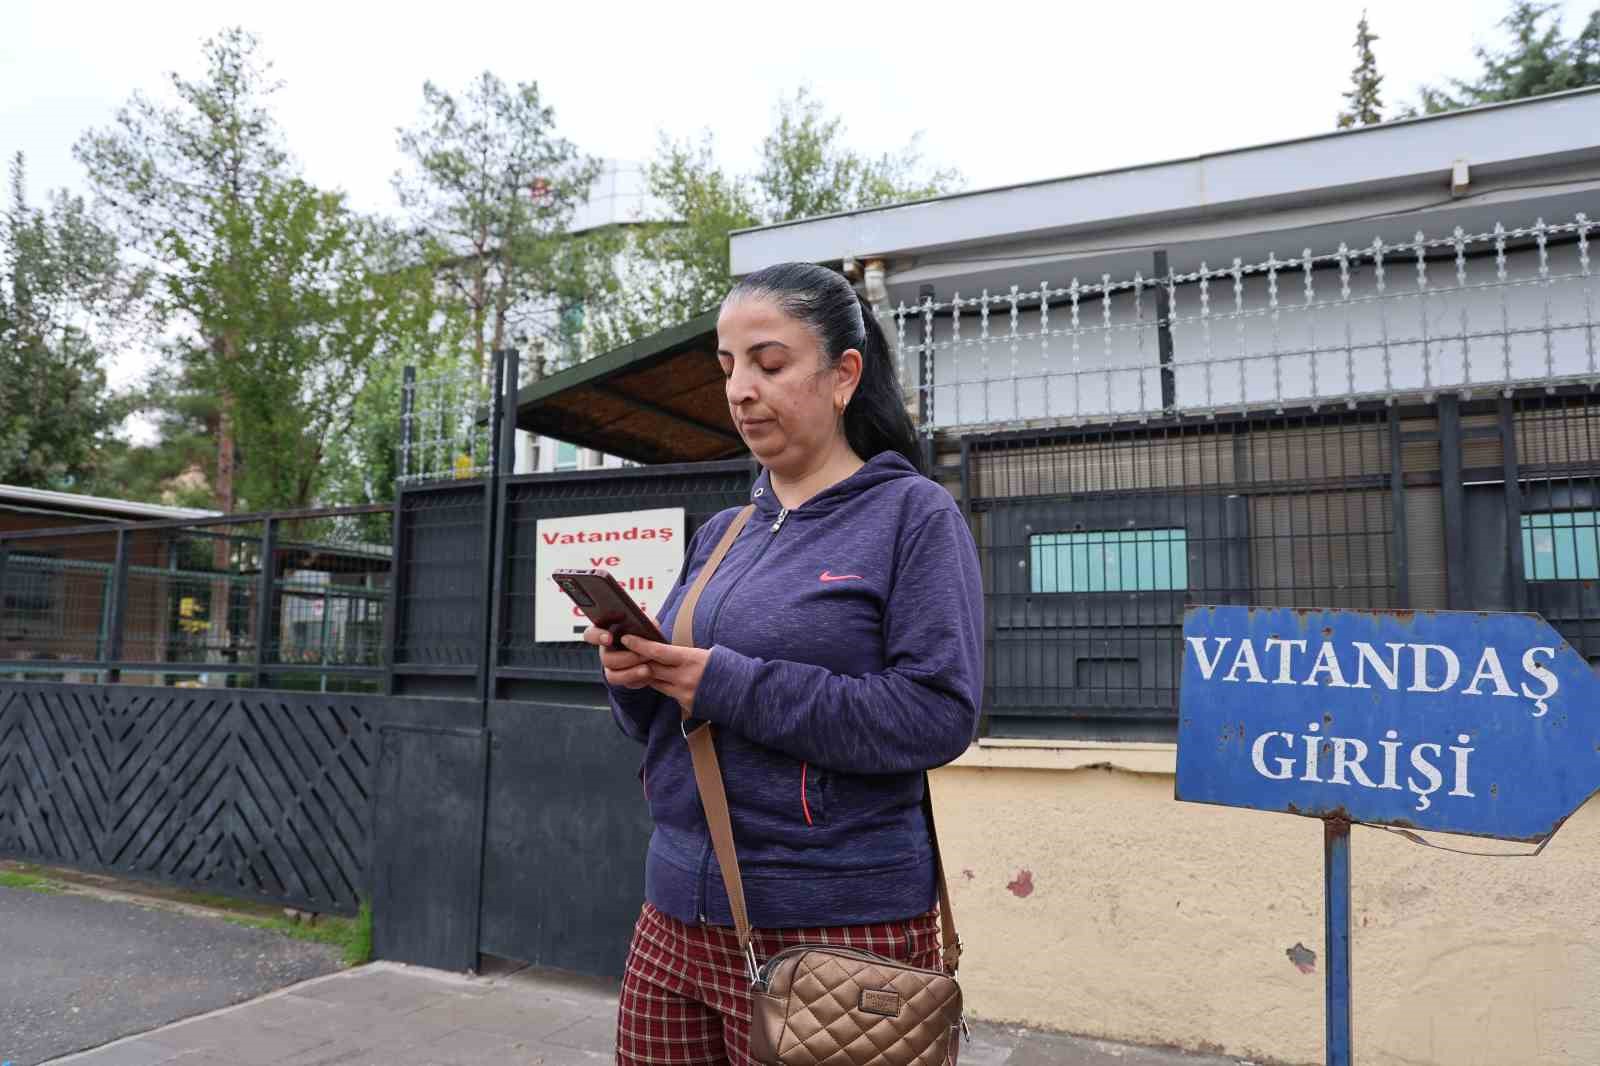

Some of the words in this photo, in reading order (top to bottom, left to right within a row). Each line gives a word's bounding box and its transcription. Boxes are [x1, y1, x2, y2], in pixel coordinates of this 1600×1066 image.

[543, 527, 673, 545] Vatandaş
[590, 555, 620, 567] ve
[1187, 637, 1559, 717] VATANDAŞ
[1252, 722, 1475, 810] GİRİŞİ
